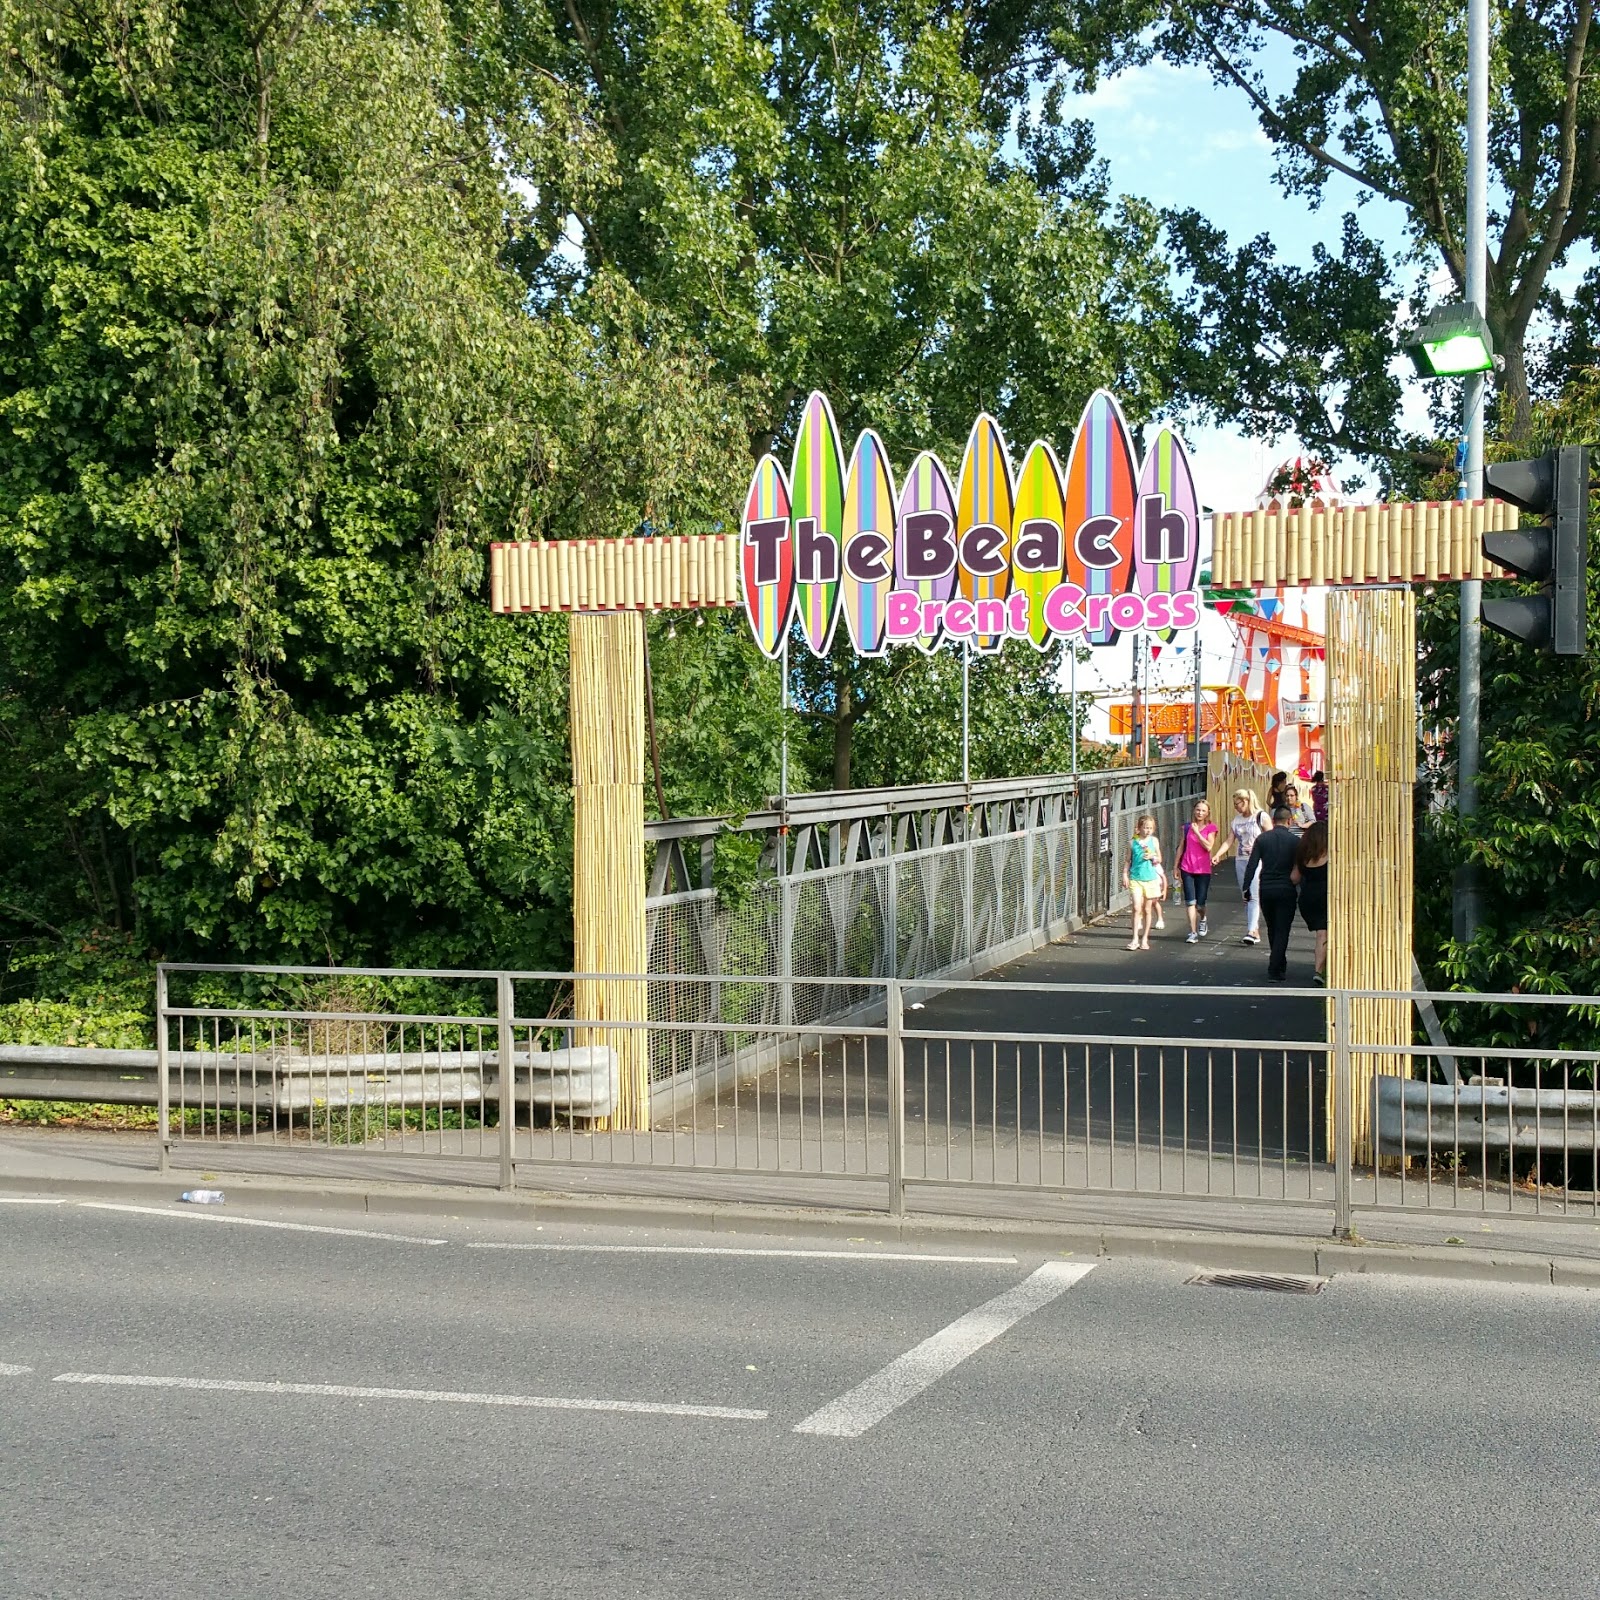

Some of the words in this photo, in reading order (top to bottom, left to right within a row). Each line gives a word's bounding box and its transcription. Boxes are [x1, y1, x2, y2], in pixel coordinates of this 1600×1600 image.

[747, 518, 892, 585] The
[903, 493, 1188, 580] Beach
[886, 589, 1028, 637] Brent
[1044, 583, 1199, 632] Cross
